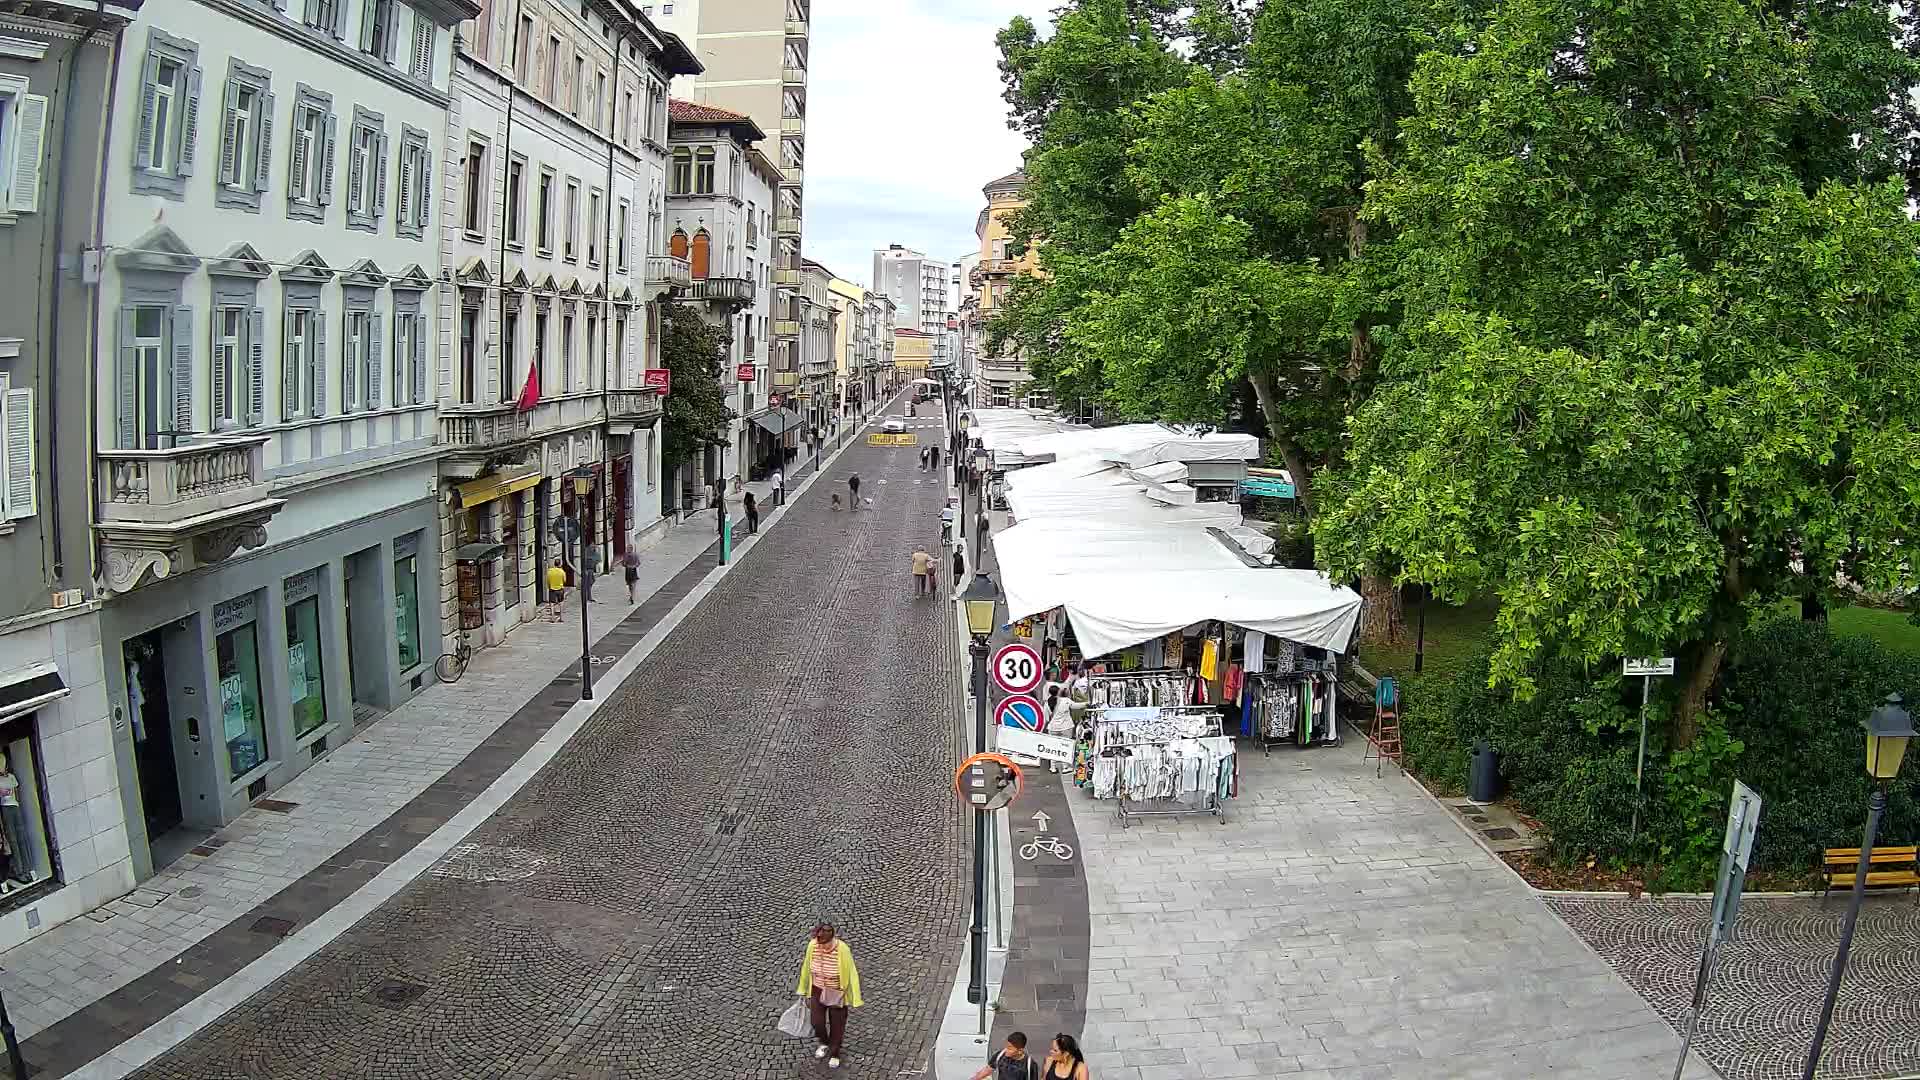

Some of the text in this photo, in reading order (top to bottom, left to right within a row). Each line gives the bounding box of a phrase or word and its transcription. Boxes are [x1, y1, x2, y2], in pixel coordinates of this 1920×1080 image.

[289, 646, 305, 667] 130
[1005, 658, 1032, 680] 30
[222, 678, 241, 700] 130
[1037, 743, 1069, 758] Dante
